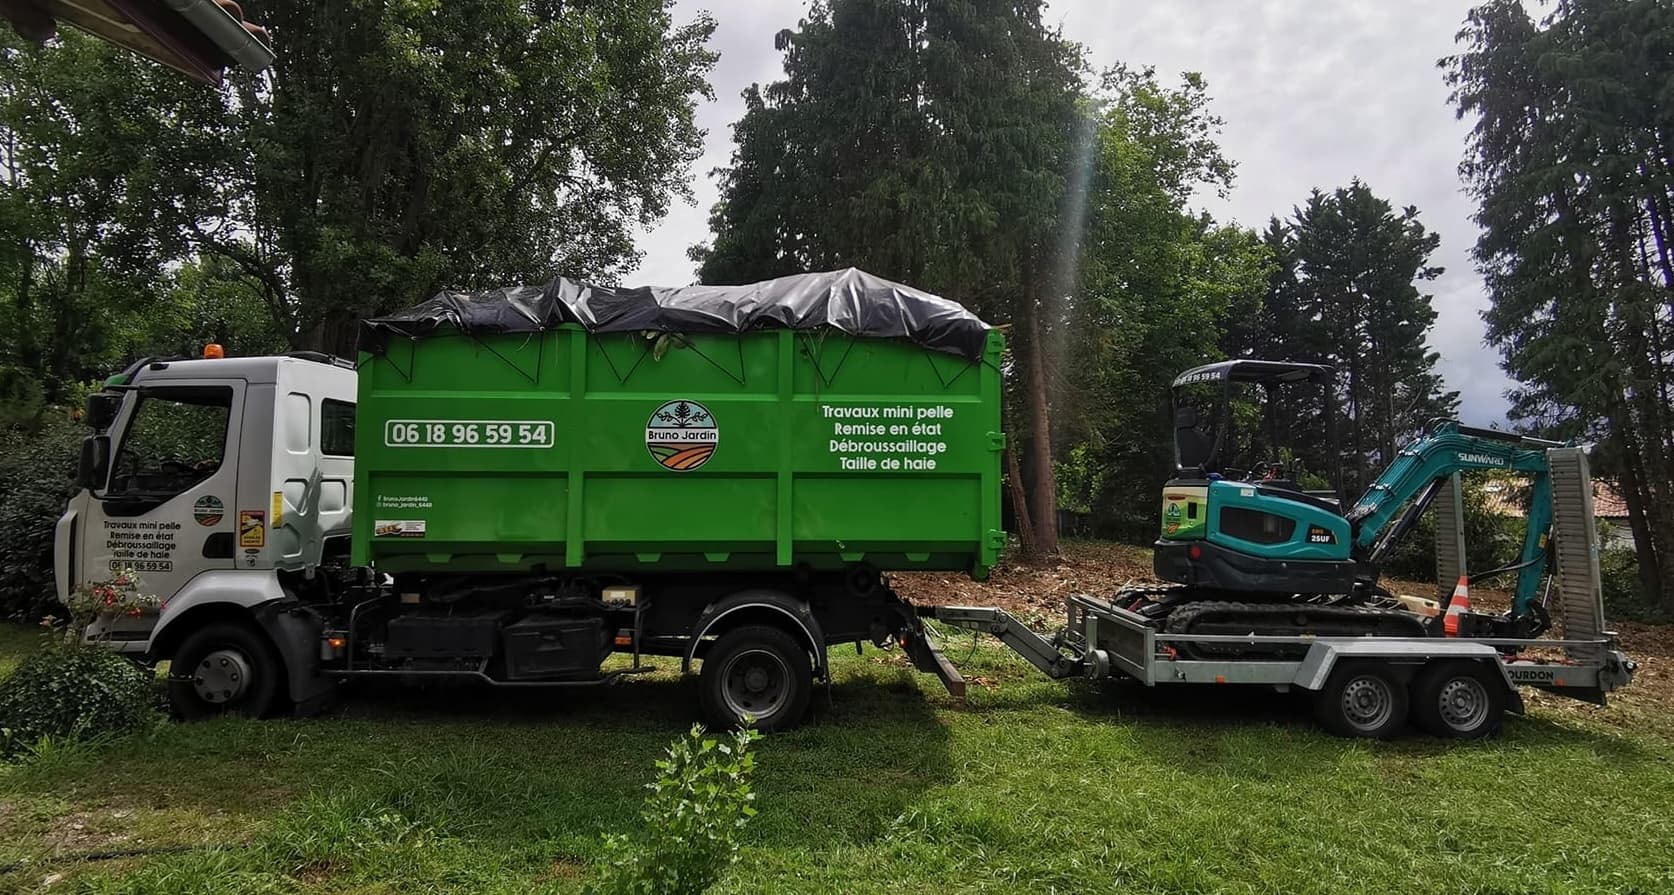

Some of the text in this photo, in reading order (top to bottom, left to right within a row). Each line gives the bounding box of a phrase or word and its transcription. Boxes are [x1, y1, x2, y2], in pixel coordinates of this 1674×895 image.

[1210, 371, 1221, 380] 54
[822, 405, 954, 420] Travaux mini pelle
[834, 421, 942, 435] Remise en état
[392, 424, 547, 444] 06 18 96 59 54
[648, 430, 717, 440] Bruno Jardin
[829, 438, 947, 455] Débroussaillage
[840, 457, 937, 470] Taille de haie
[1458, 452, 1504, 466] SUNWARD
[104, 520, 181, 531] Travaux mini pelle
[110, 531, 141, 540] Remise
[156, 531, 174, 540] état
[1311, 535, 1330, 543] 25UF
[106, 540, 177, 551] Débroussaillage
[136, 550, 149, 559] de
[150, 550, 170, 559] haie
[134, 562, 145, 570] 96
[147, 562, 157, 570] 59
[159, 562, 170, 570] 54
